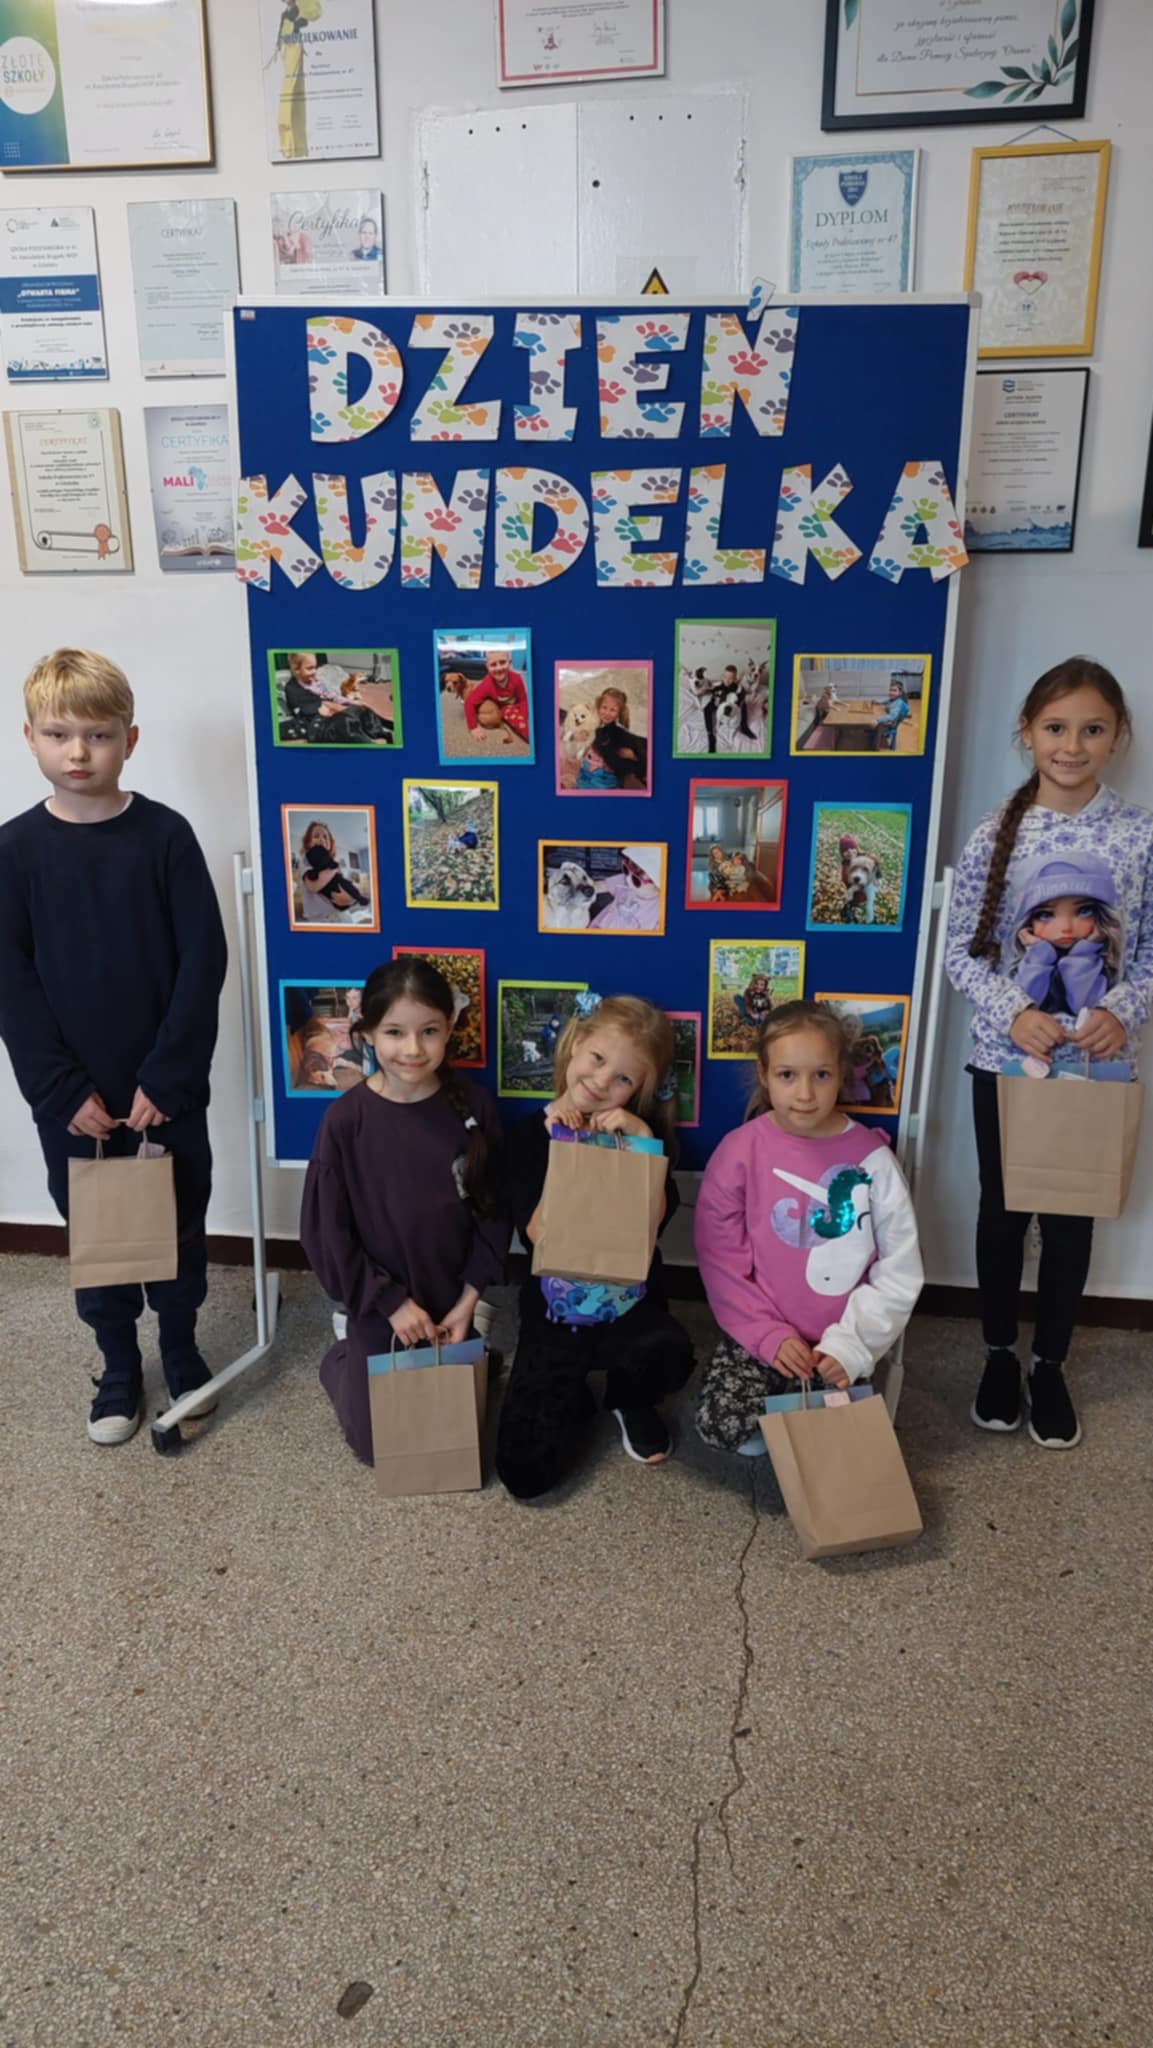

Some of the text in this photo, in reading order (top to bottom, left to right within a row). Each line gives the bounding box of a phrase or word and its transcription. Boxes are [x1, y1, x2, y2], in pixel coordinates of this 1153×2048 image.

[281, 28, 359, 44] DZIĘKOWANIE
[815, 208, 888, 228] DYPLOM
[306, 276, 799, 443] DZIEŃ
[161, 433, 229, 449] CERTYFIKA
[162, 476, 194, 488] MALI
[235, 461, 970, 592] KUNDELKA
